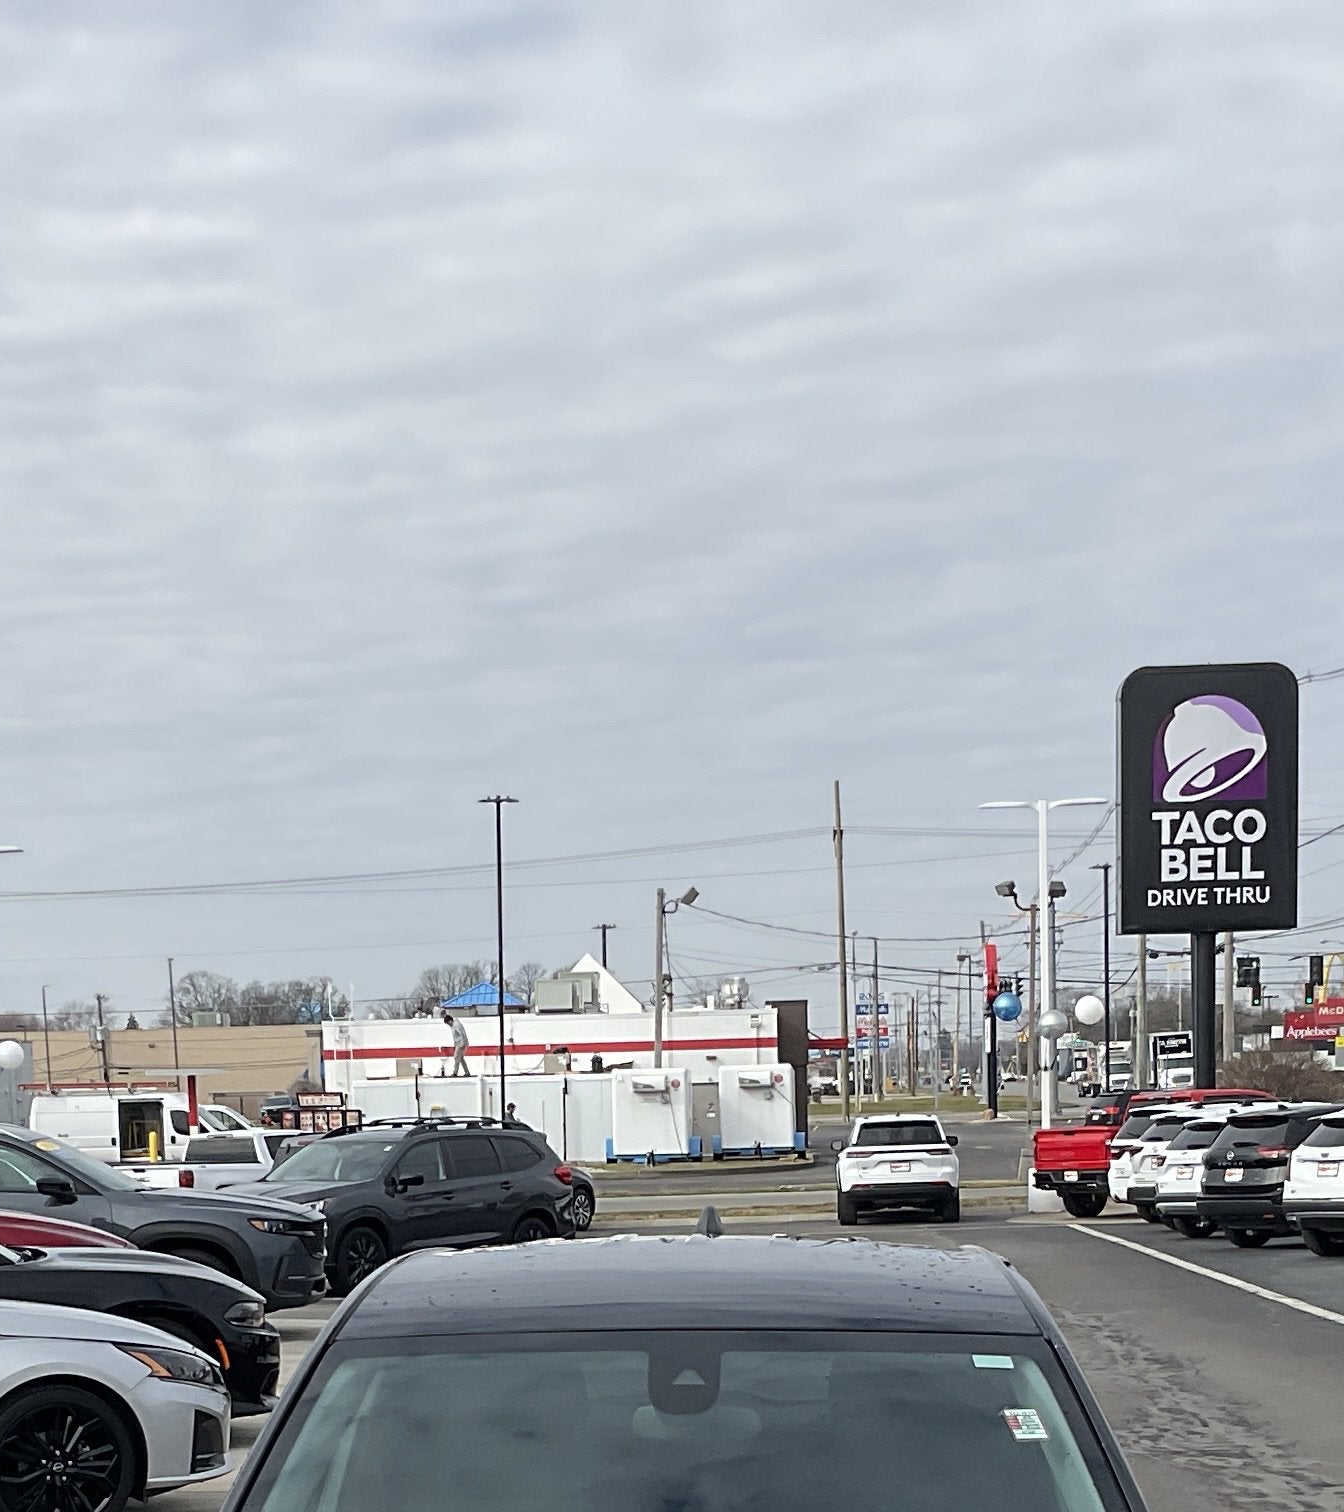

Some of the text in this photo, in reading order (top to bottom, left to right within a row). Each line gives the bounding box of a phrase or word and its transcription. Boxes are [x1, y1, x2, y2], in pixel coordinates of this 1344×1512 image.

[1151, 809, 1267, 846] TACO
[1161, 846, 1265, 882] BELL
[1147, 885, 1271, 907] DRIVE THRU
